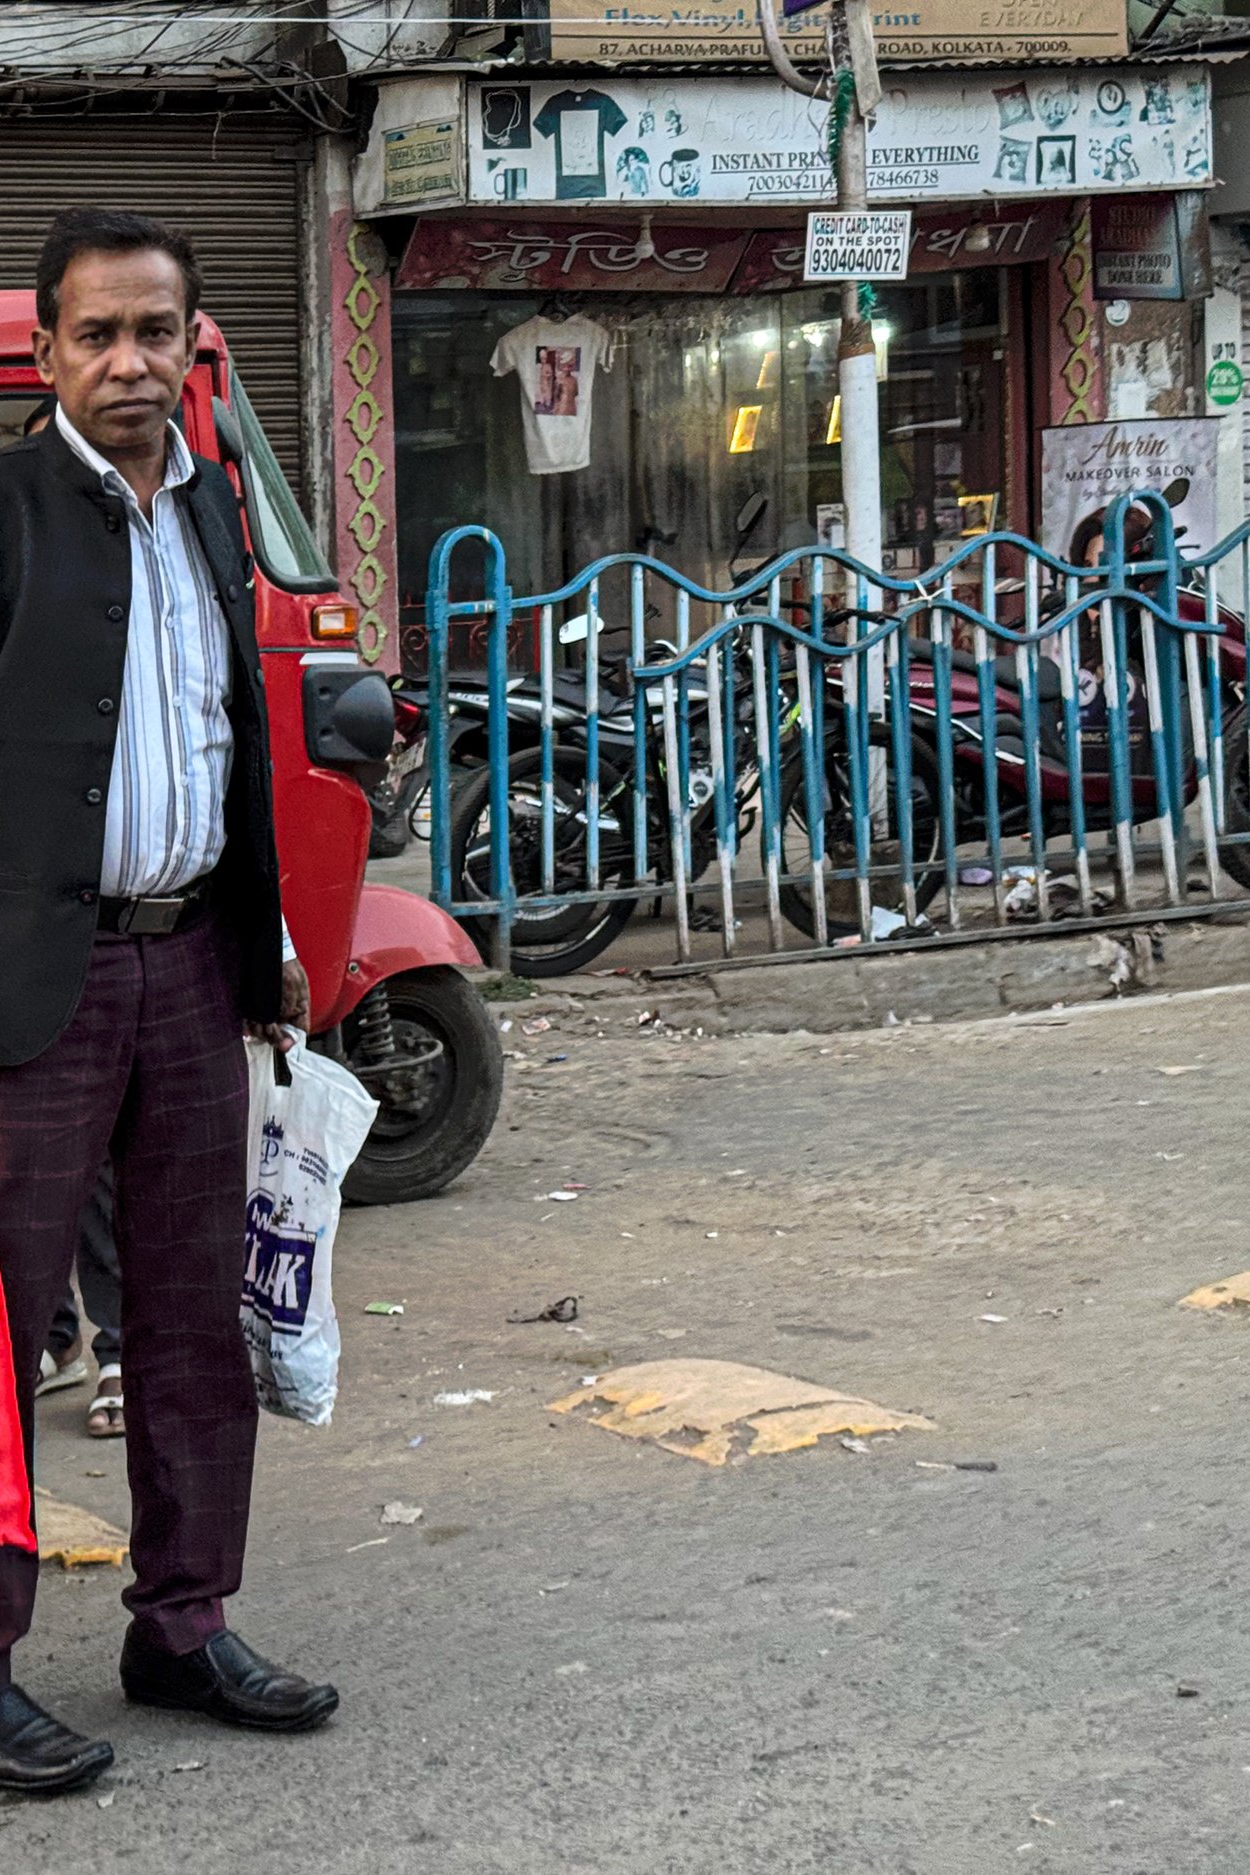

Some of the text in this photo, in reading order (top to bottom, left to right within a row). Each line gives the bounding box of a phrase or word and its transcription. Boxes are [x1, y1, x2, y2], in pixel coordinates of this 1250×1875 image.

[872, 9, 921, 26] rint
[599, 43, 623, 57] 87,
[626, 42, 706, 56] ACHARYA
[877, 42, 928, 56] ROAD,
[932, 41, 1004, 55] KOLKATA
[711, 144, 980, 171] INSTANT PRIN EVERYTHING
[814, 216, 905, 235] CREDIT CARD-TO-CASH
[816, 235, 900, 247] ON THE SPOT
[464, 229, 710, 282] স্টুডিও
[812, 248, 901, 272] 9304040072
[1065, 464, 1195, 483] MAKEOVER SALON
